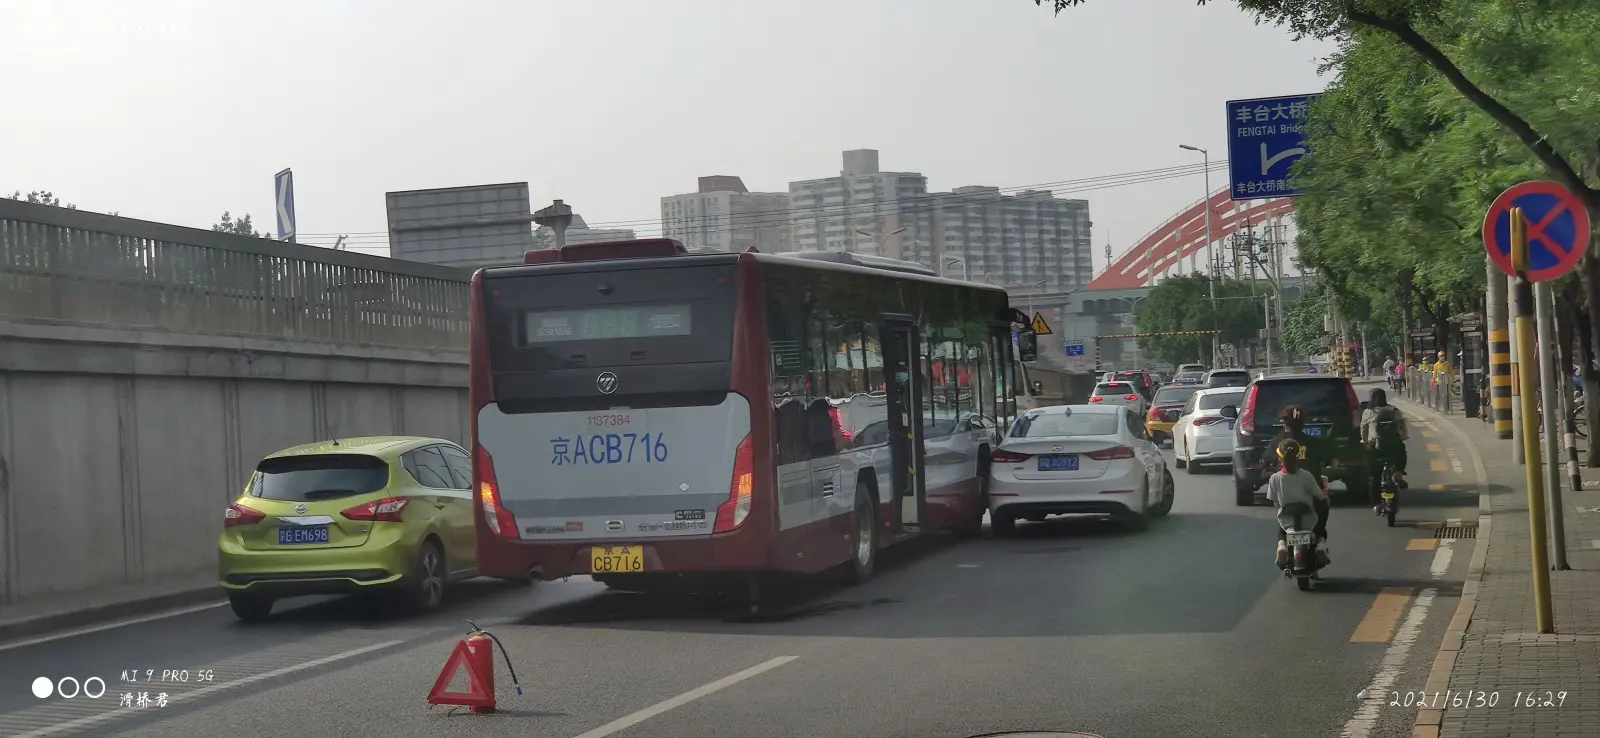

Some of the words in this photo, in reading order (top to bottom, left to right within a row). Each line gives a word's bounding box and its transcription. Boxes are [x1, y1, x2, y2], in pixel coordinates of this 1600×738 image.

[1236, 101, 1307, 123] 丰台大桥
[1237, 125, 1276, 137] FENGTAI
[588, 415, 630, 426] 1137384
[550, 432, 667, 466] 京ACB716
[594, 556, 641, 571] CB716
